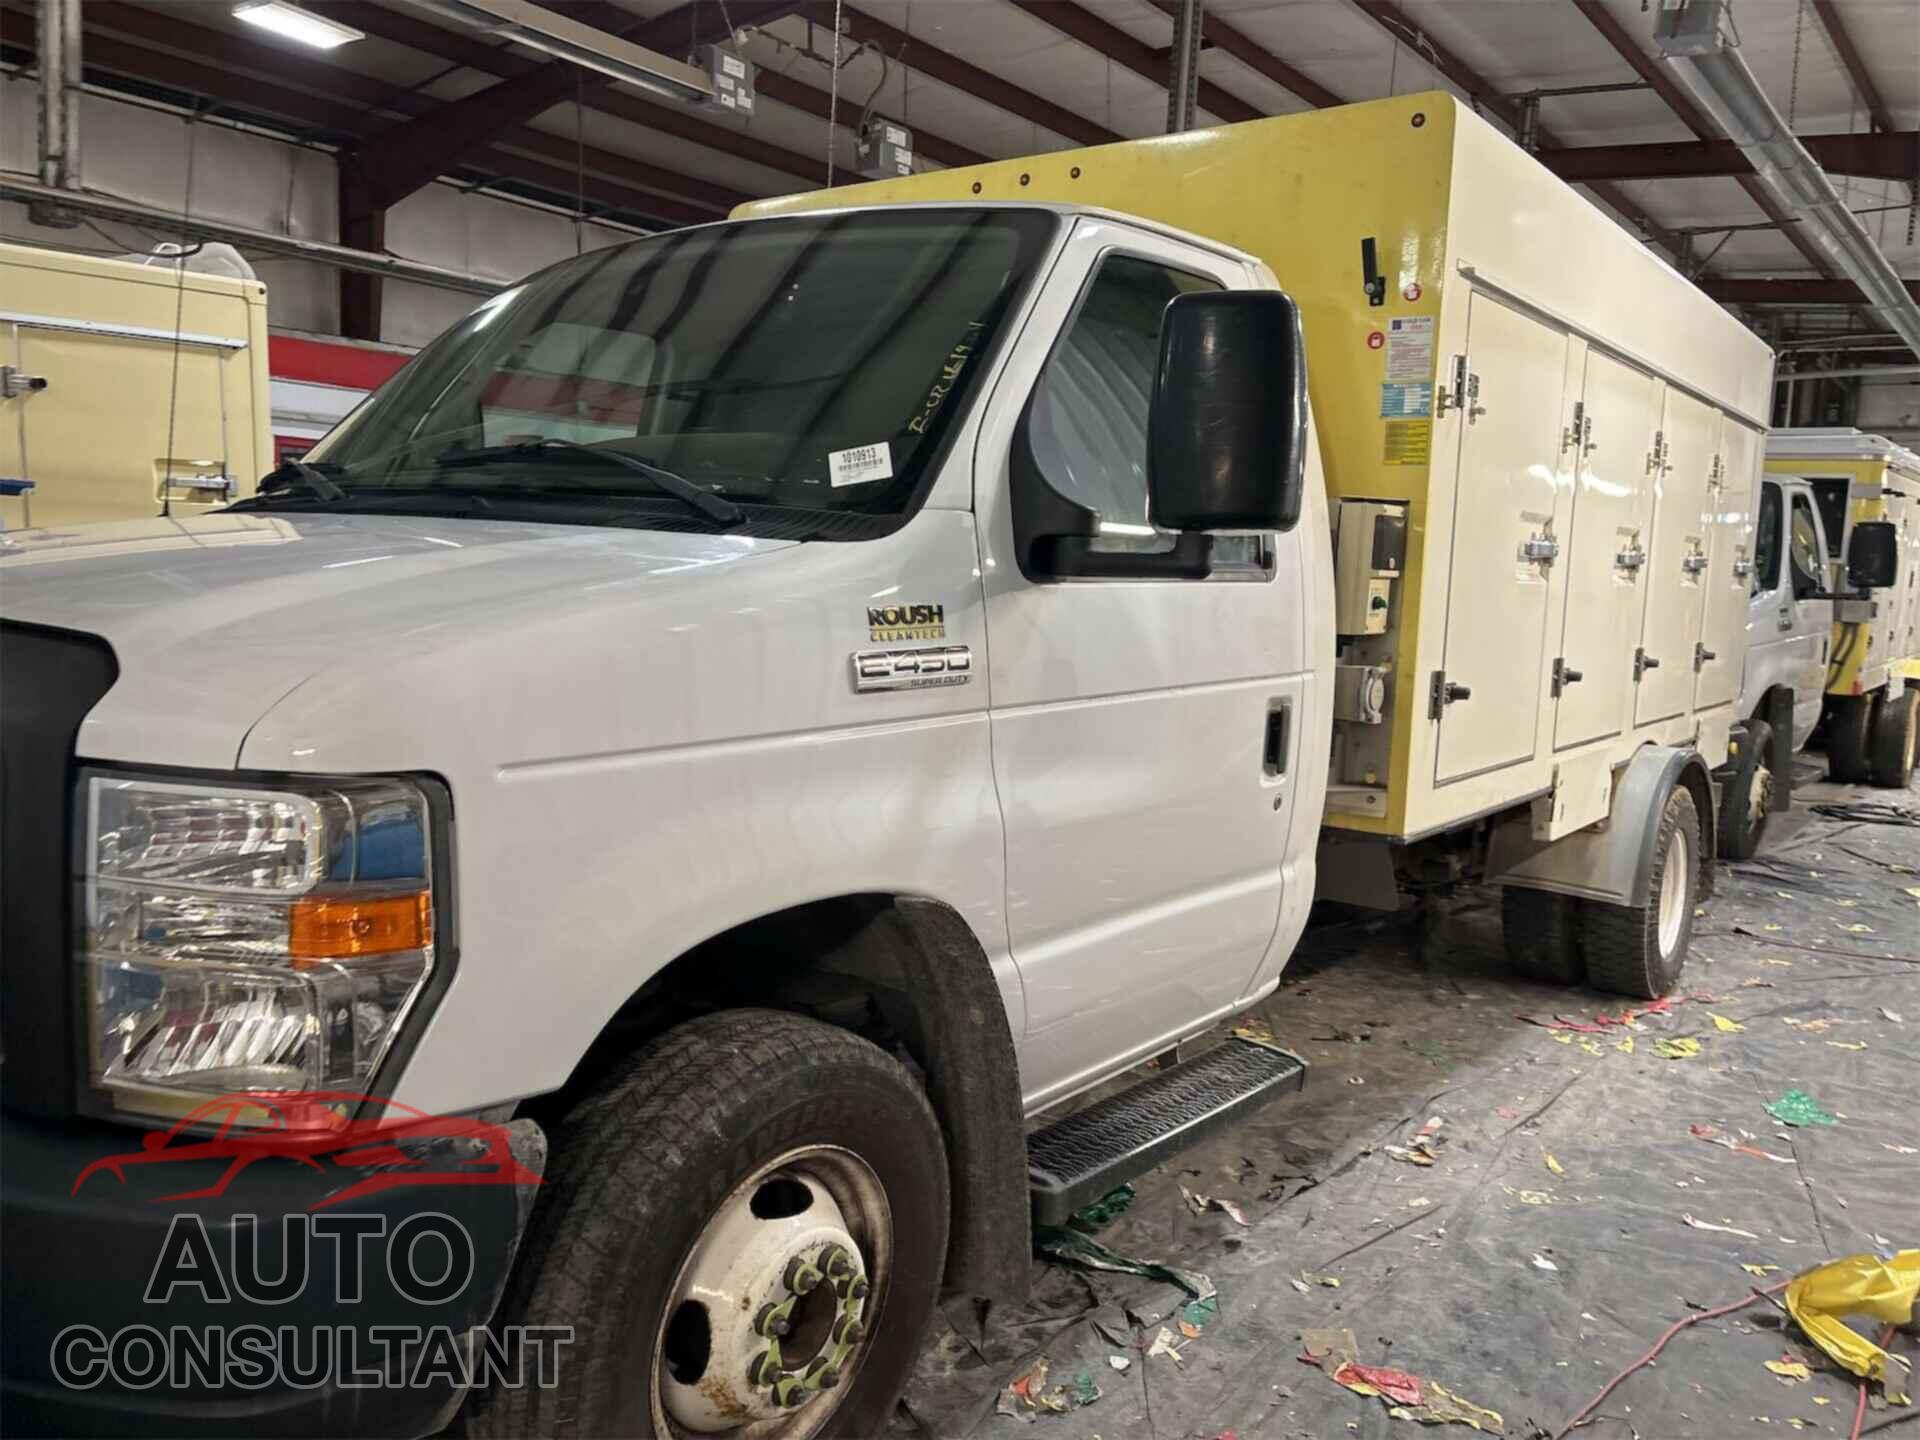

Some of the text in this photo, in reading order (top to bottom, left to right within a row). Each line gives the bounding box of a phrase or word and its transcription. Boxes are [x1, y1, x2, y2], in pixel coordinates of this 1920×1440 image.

[843, 447, 876, 463] 1010913
[868, 604, 944, 626] ROUSH
[870, 629, 945, 642] CLEANTECH
[858, 648, 970, 677] E450
